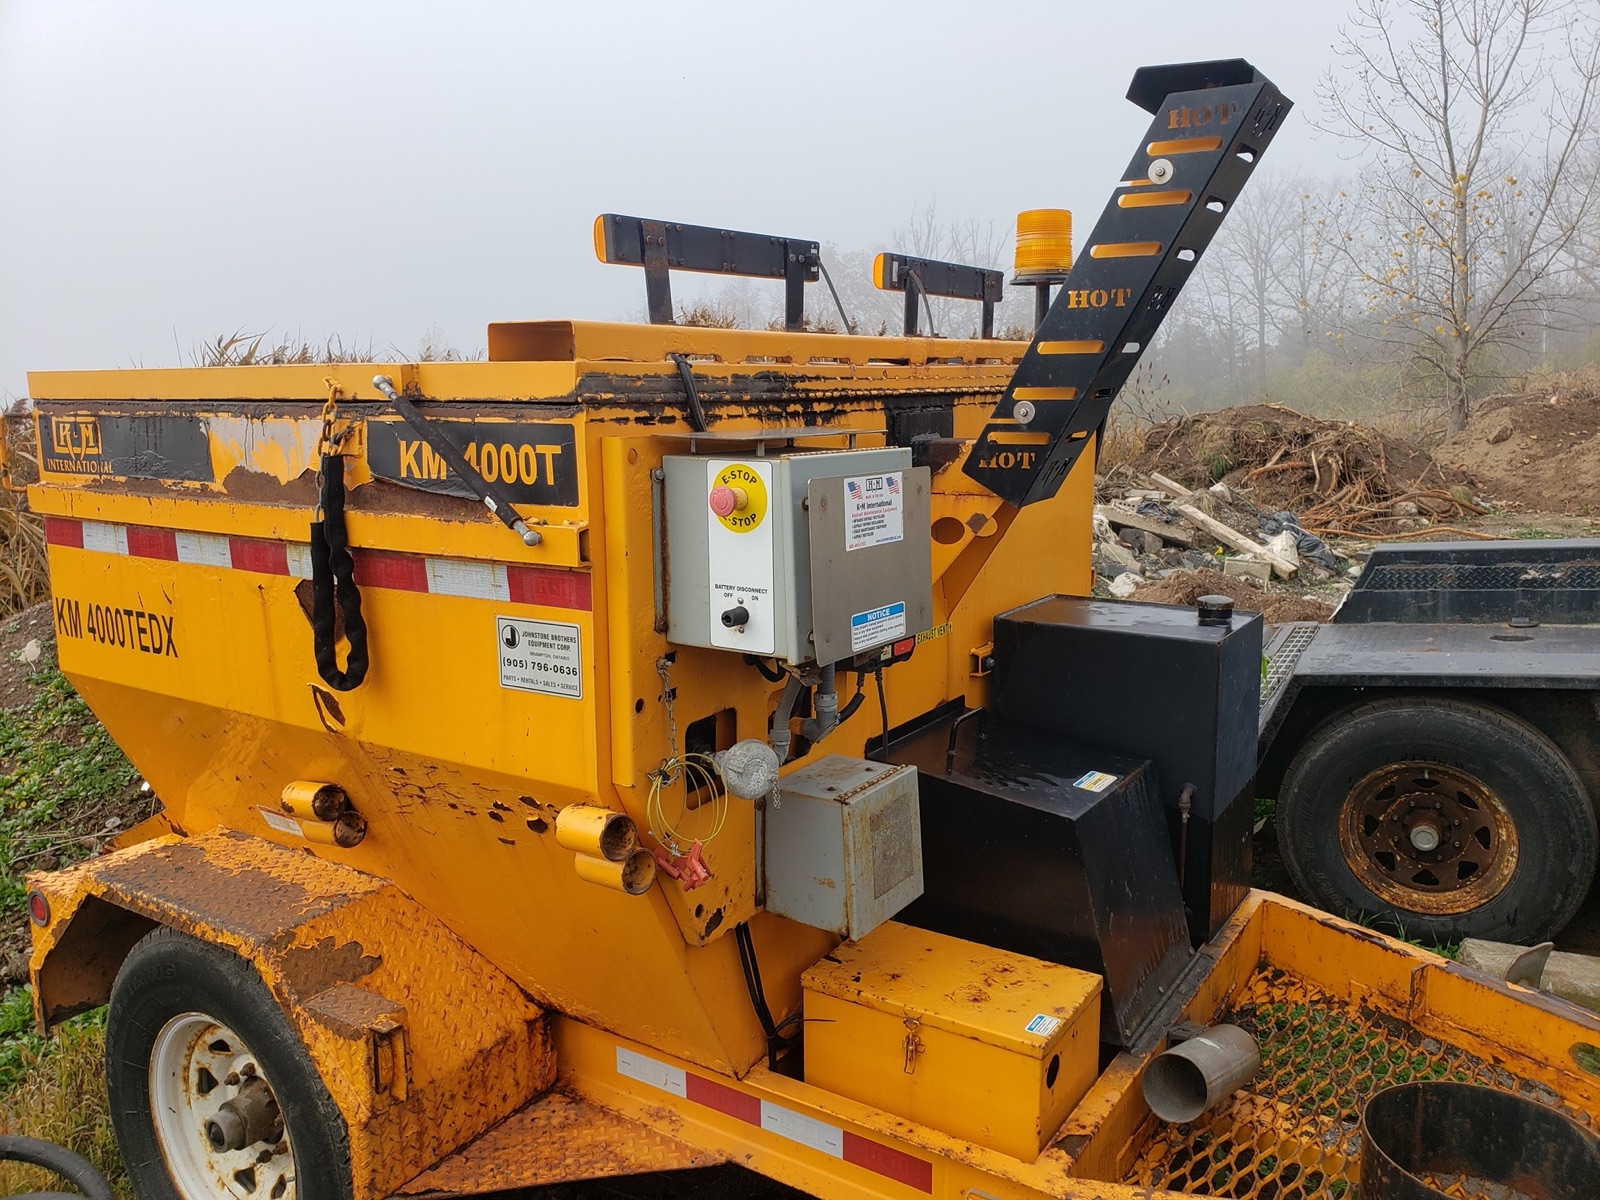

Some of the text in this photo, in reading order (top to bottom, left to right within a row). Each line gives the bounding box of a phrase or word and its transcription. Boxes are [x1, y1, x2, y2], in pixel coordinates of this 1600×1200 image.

[1168, 103, 1237, 129] HOT
[1067, 288, 1132, 310] HOT
[47, 458, 114, 474] INTERNATIONAL
[979, 452, 1036, 470] HOT
[721, 469, 757, 485] E-STOP
[866, 498, 893, 509] International
[715, 583, 768, 595] BATTERY DISCONNECT
[867, 607, 891, 621] NOTICE
[55, 596, 179, 659] KM 4000TEDX
[521, 630, 577, 644] JOHNSTONE BROTHERS
[917, 627, 937, 645] EXHAUST
[527, 639, 572, 652] EQUIPMENT CORP.
[502, 656, 528, 670] (905)
[503, 674, 579, 692] PARTS RENTALS SALES SERVICE
